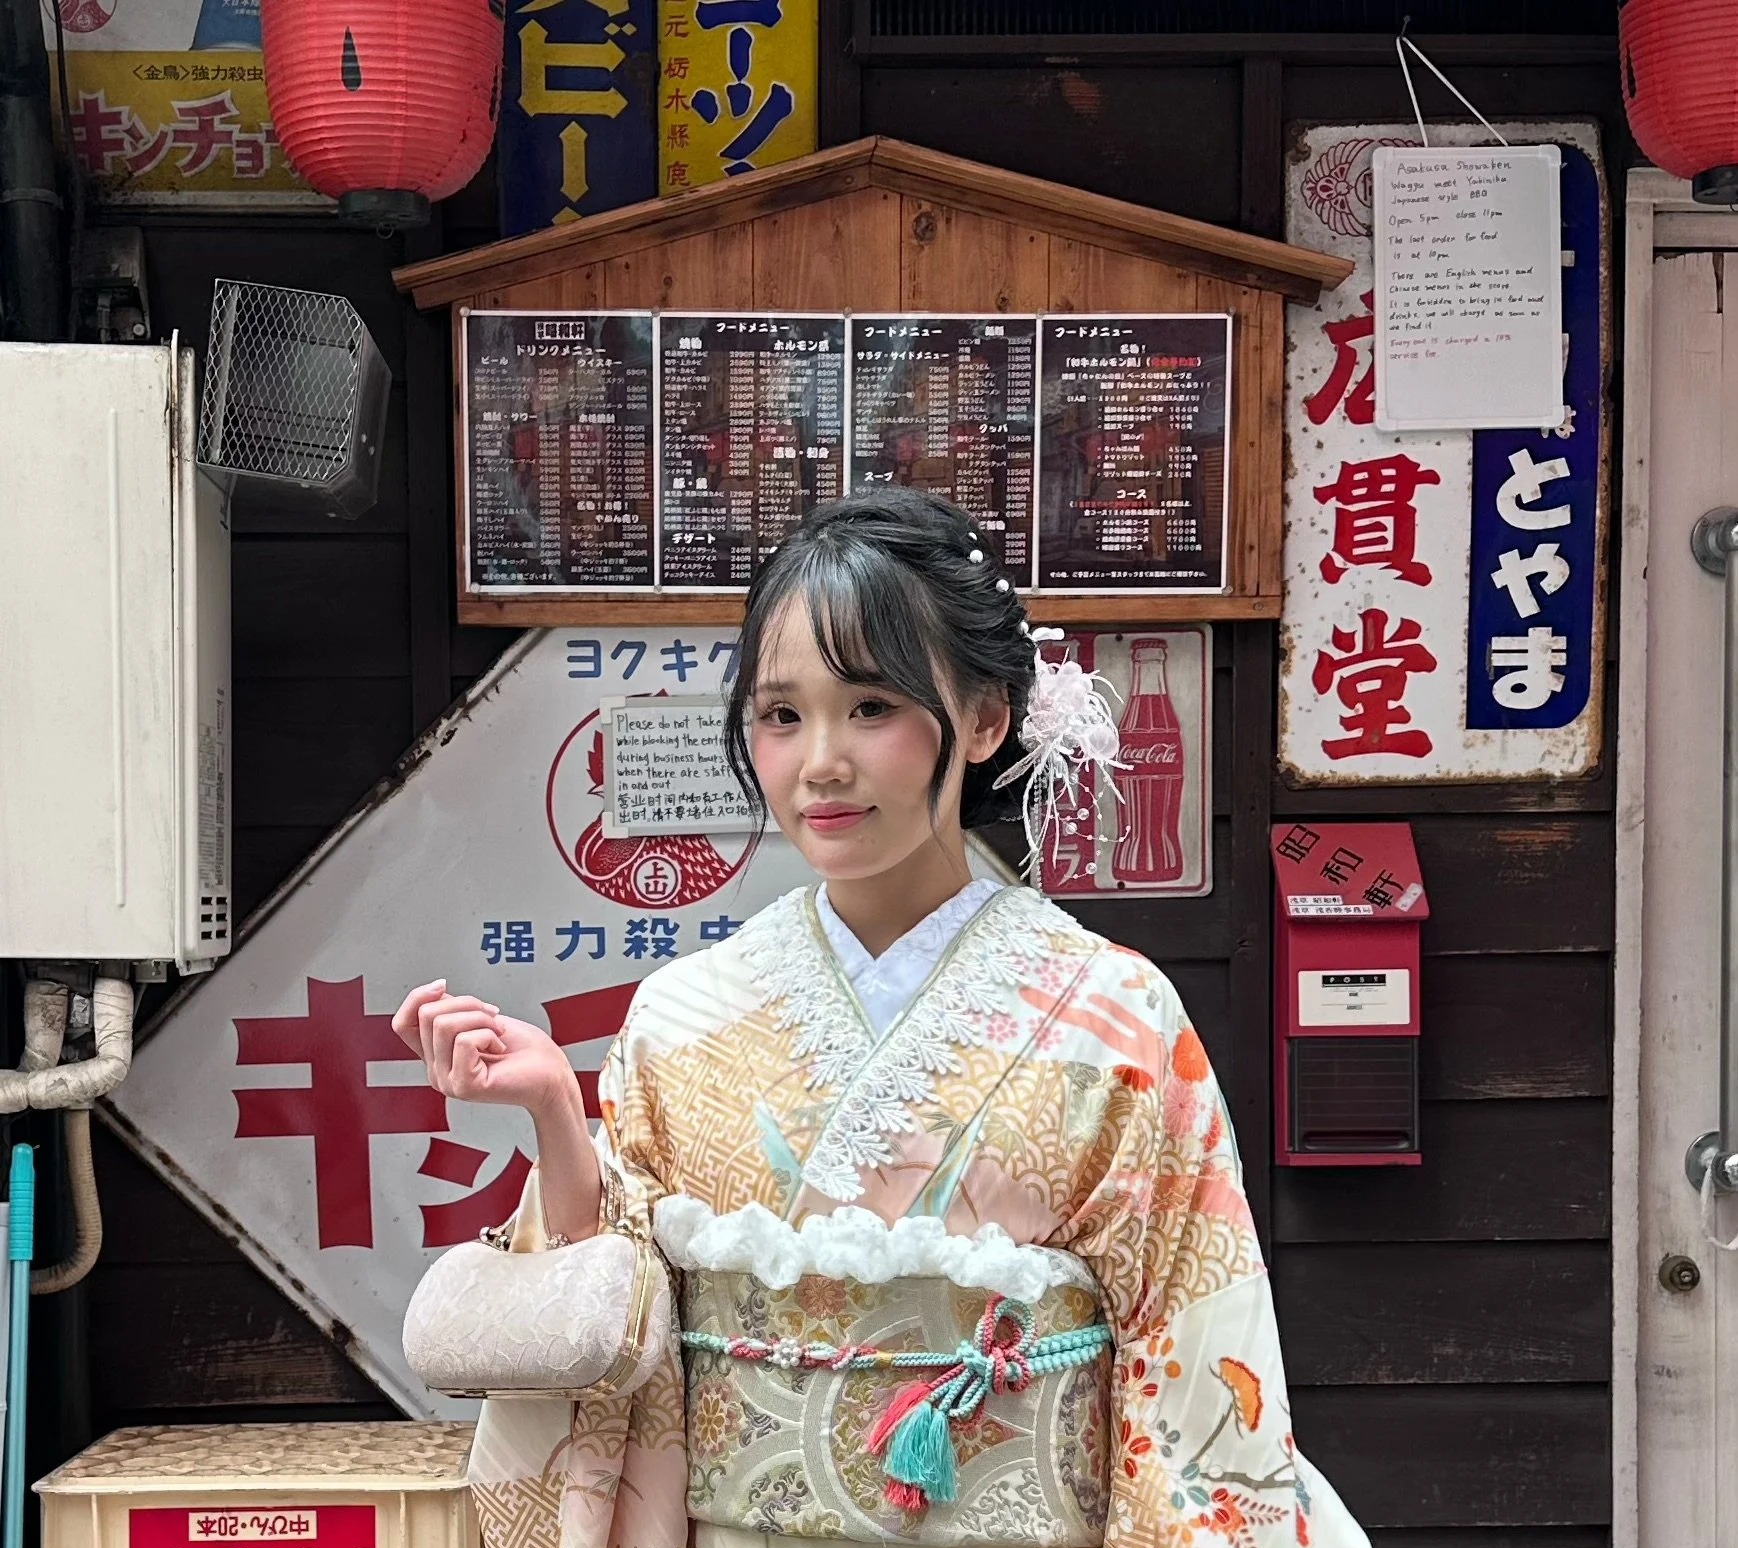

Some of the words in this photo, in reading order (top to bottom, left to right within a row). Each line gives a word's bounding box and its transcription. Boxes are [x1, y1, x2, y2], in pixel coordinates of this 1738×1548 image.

[1397, 162, 1448, 175] Asakusa
[1470, 189, 1488, 199] BBQ
[1388, 215, 1412, 228] Open
[1419, 213, 1439, 225] 5pm
[1483, 208, 1503, 218] 11pm
[1388, 236, 1403, 244] The
[1431, 234, 1455, 243] order
[1446, 268, 1476, 280] English
[716, 322, 790, 333] フードメニュー
[864, 326, 943, 338] フードメニュー
[1055, 326, 1134, 338] フードメニュー
[516, 344, 607, 356] ドリンクメニュー
[856, 351, 950, 361] サラダ・サイドメニュー
[480, 356, 509, 366] ビール
[577, 358, 623, 368] ウイスキー
[978, 423, 1009, 434] クッパ
[863, 471, 894, 482] スープ
[1116, 489, 1147, 499] コース
[671, 533, 717, 544] デザート
[617, 713, 655, 732] Please
[658, 714, 671, 730] do
[674, 714, 690, 729] not
[697, 715, 722, 729] take
[616, 735, 639, 747] while
[682, 733, 699, 748] the
[617, 750, 650, 767] during
[653, 751, 695, 764] business
[617, 766, 643, 777] when
[646, 765, 677, 780] there
[618, 780, 629, 791] in
[631, 781, 649, 790] and
[651, 779, 671, 790] out
[1276, 824, 1404, 910] 昭和軒
